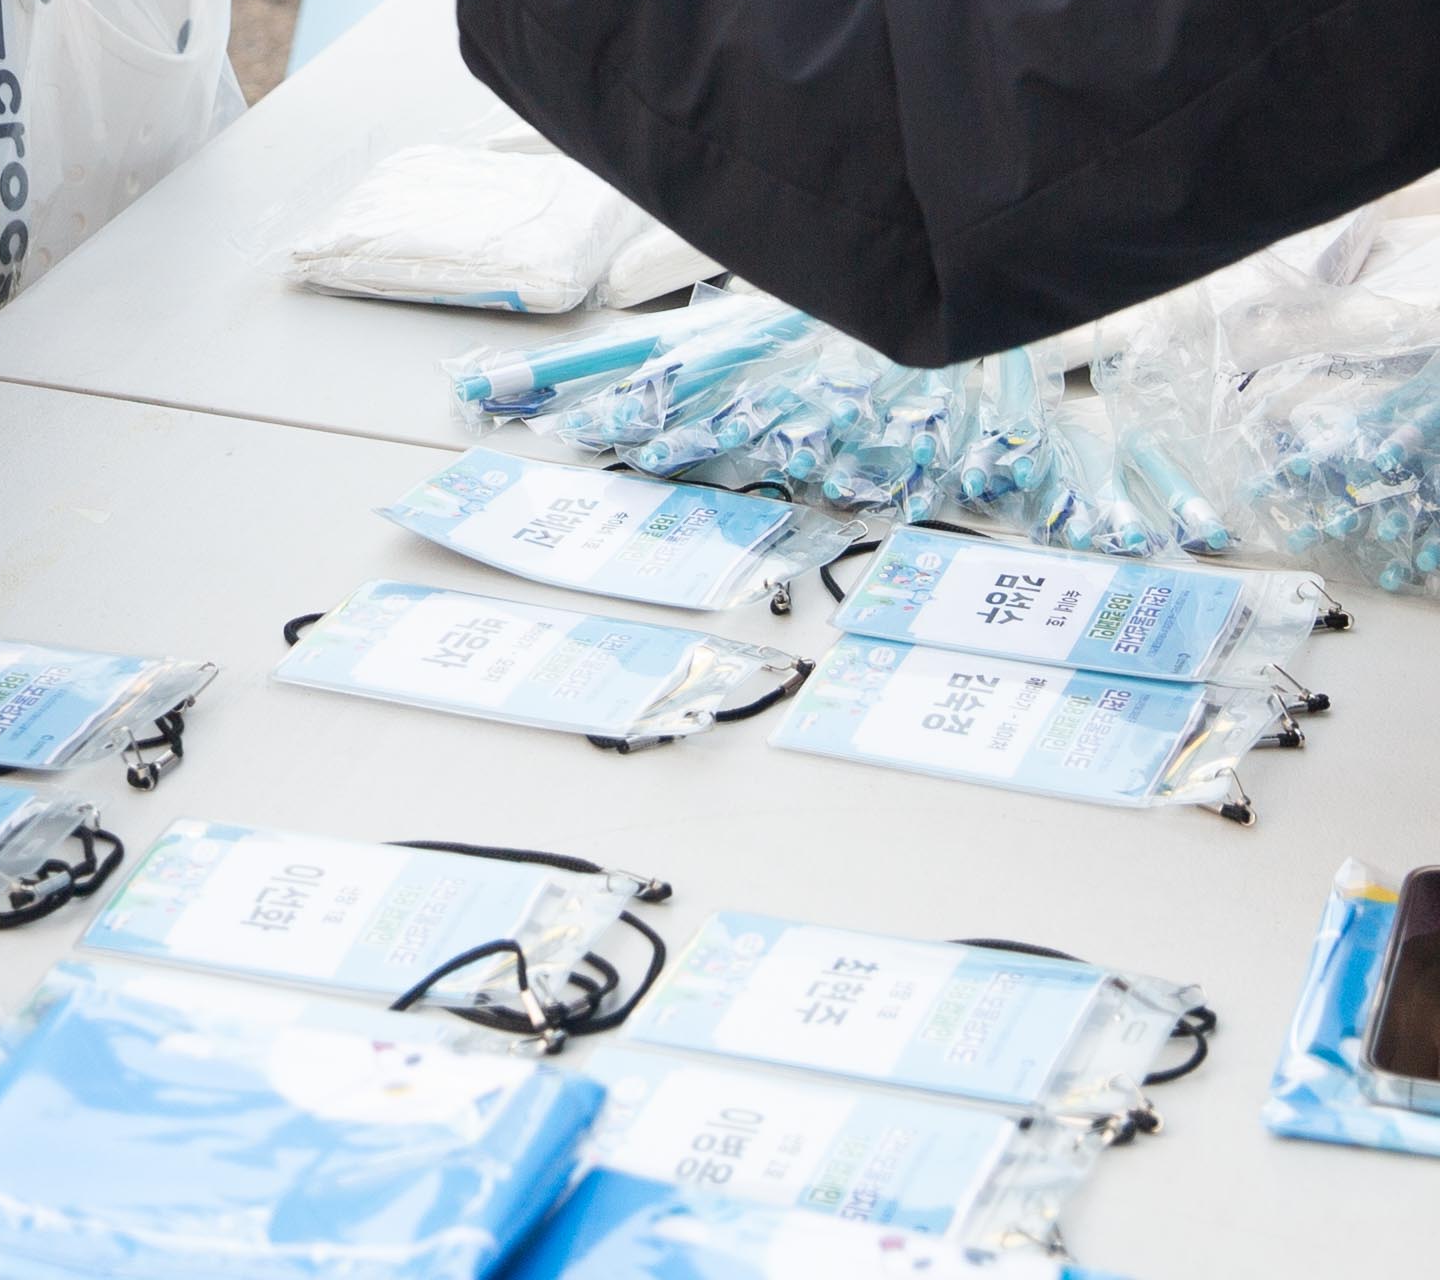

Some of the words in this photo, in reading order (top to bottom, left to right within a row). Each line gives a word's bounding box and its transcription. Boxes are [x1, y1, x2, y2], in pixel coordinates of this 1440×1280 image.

[644, 511, 682, 532] 168
[679, 506, 719, 528] 인천
[971, 571, 1047, 628] 김성수
[1052, 588, 1083, 613] 숙이네
[1104, 591, 1135, 610] 168
[1138, 585, 1174, 608] 인천
[1044, 614, 1068, 627] 1호
[1087, 609, 1127, 641] 캠페인
[1112, 605, 1162, 655] 보물섬지도
[414, 614, 512, 670] 박은자
[918, 670, 1002, 736] 김숙경
[1060, 693, 1093, 715] 168
[1095, 688, 1134, 712] 인천
[233, 861, 339, 934] 이선화
[788, 955, 882, 1029] 최현주
